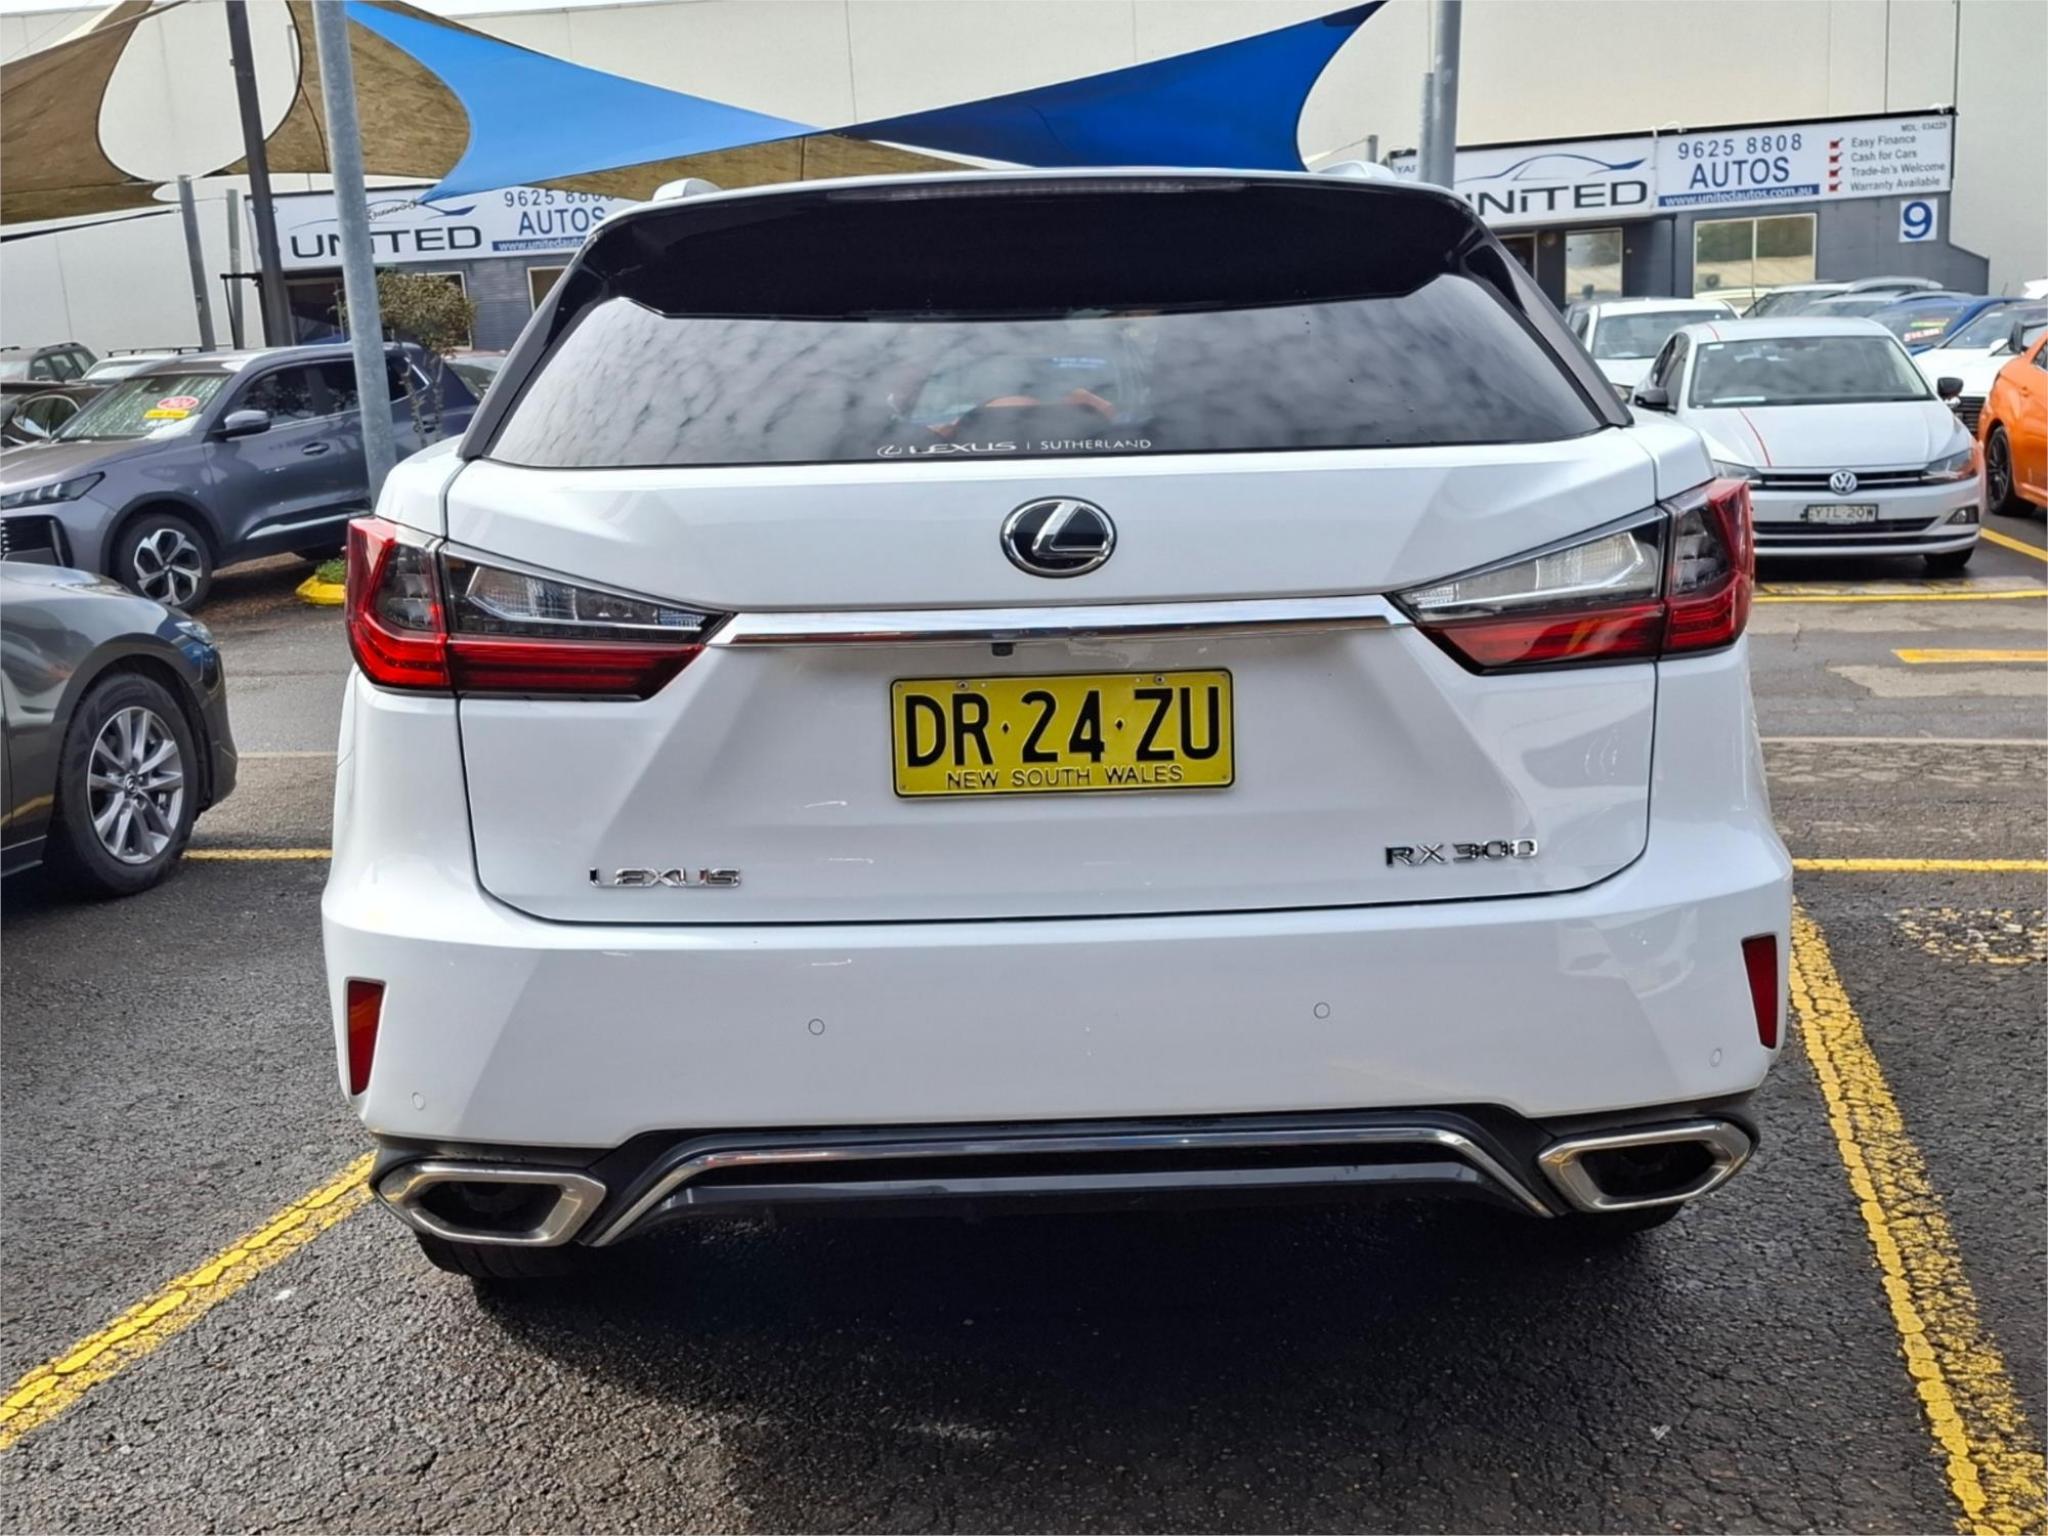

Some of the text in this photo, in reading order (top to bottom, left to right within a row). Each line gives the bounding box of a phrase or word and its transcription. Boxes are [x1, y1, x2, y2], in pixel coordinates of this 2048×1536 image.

[1678, 133, 1802, 160] 9625 8808
[1851, 135, 1916, 149] Easy Finance
[1851, 149, 1917, 162] Cash for Cars
[1689, 157, 1790, 189] AUTOS
[1901, 162, 1945, 173] Welcome
[1850, 176, 1940, 192] Warranty Available
[504, 190, 555, 207] 9625
[1465, 180, 1647, 217] NITED
[1665, 186, 1813, 206] www.unitedautos.com.au
[1903, 200, 1933, 239] 9
[909, 439, 1152, 455] LEXUS SUTHERLAND
[947, 763, 1183, 791] NEW SOUTH WALES
[589, 868, 742, 889] LEXUS
